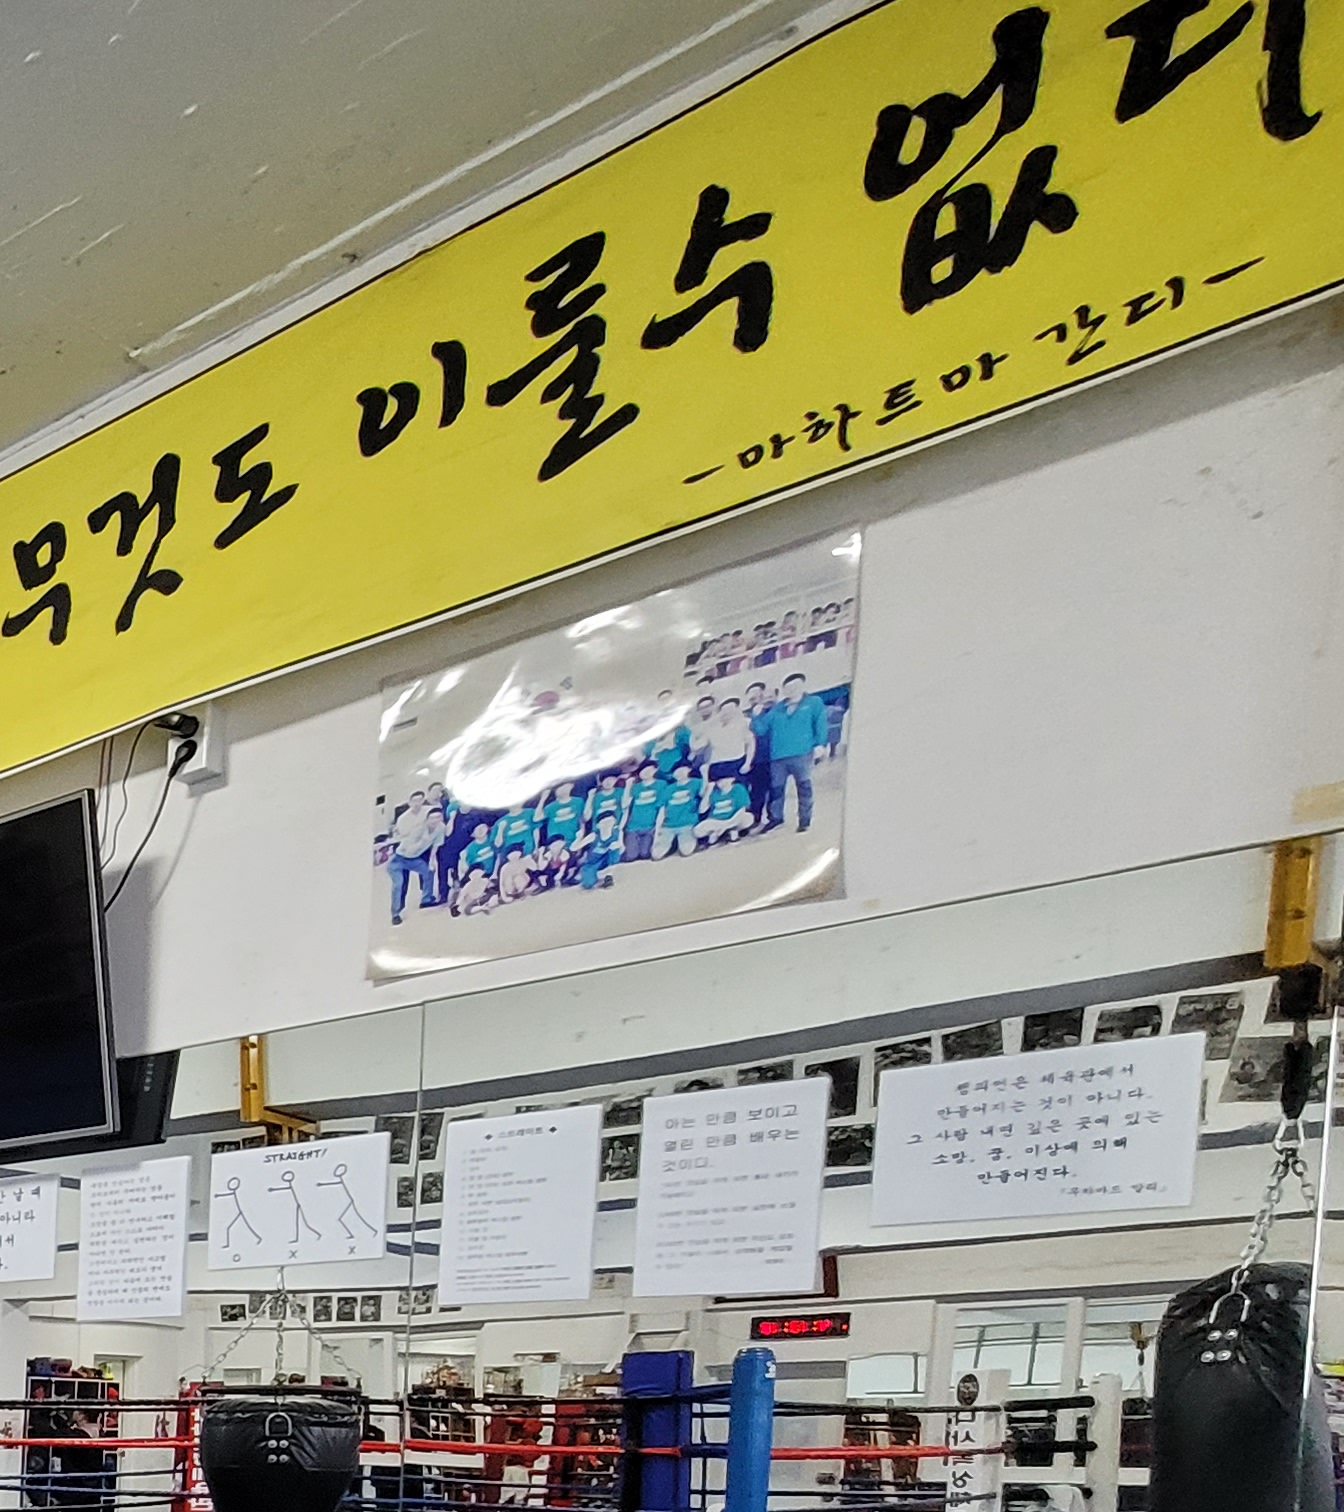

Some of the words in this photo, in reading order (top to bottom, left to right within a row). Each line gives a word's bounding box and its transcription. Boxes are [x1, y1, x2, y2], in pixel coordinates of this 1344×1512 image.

[1040, 1063, 1135, 1084] 체육관에서
[665, 1117, 696, 1129] 아는
[706, 1111, 737, 1126] 만큼
[747, 1104, 798, 1121] 보이고
[937, 1100, 1026, 1120] 만들어지는
[1039, 1094, 1072, 1110] 것이
[906, 1134, 923, 1145] 그
[935, 1128, 969, 1141] 사람
[980, 1123, 1014, 1137] 내면
[1027, 1118, 1063, 1135] 깊은
[1075, 1115, 1109, 1130] 곳에
[1124, 1110, 1164, 1126] 있는
[664, 1138, 694, 1152] 열린
[706, 1133, 737, 1148] 만큼
[749, 1128, 800, 1143] 배우는
[1025, 1141, 1079, 1157] 이상에
[1091, 1136, 1128, 1151] 의해
[662, 1157, 715, 1172] 것이다.
[13, 1187, 24, 1202] 날
[0, 1209, 36, 1225] 아니라
